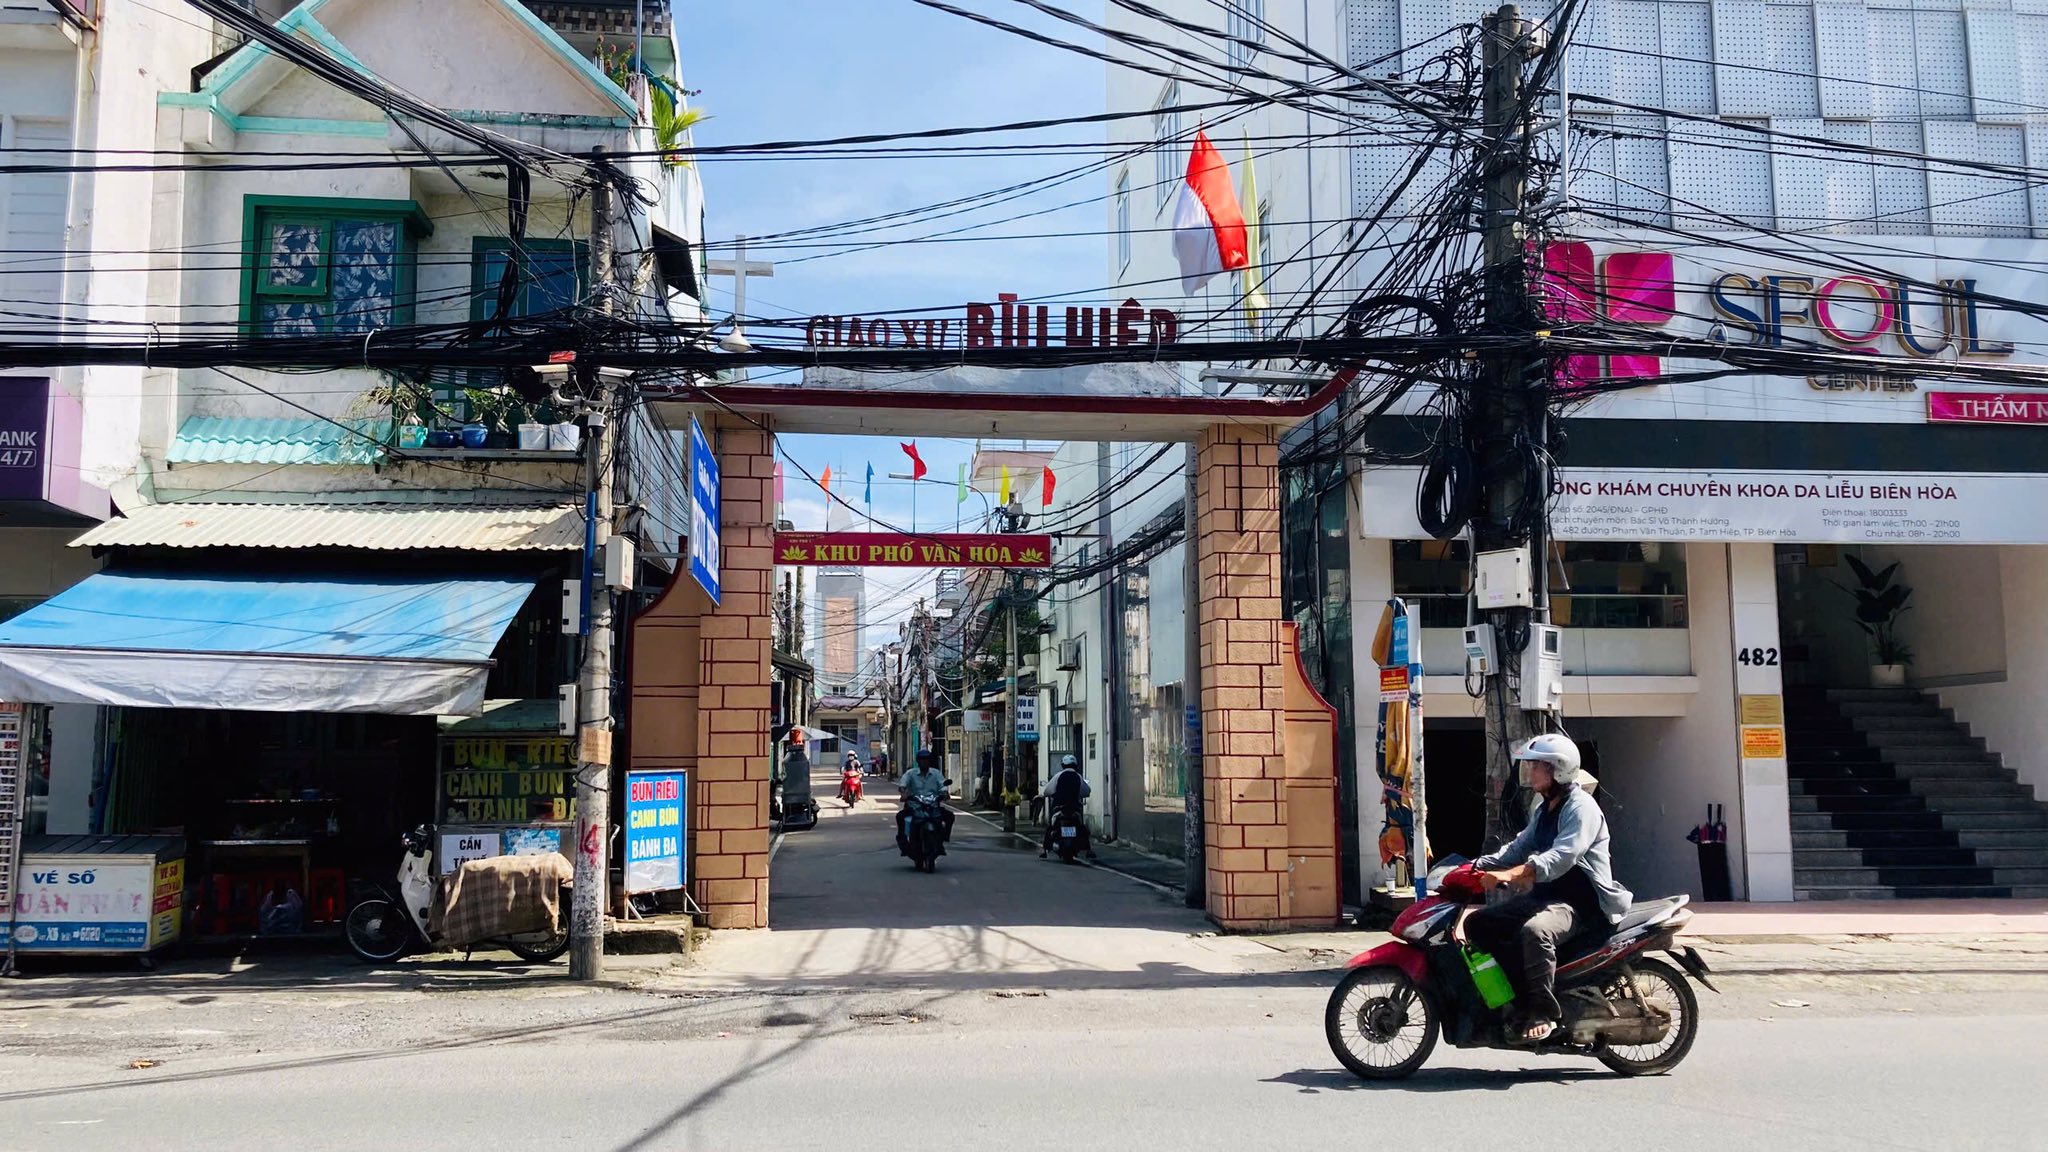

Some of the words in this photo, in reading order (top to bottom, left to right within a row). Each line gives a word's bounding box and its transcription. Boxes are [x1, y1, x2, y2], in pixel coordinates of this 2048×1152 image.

[1710, 273, 2014, 358] SEOUL
[1807, 373, 1917, 393] CENTER
[1957, 394, 2028, 419] THẨM
[1597, 479, 1652, 496] KHÁM
[1657, 480, 1732, 497] CHUYÊN
[1738, 484, 1789, 498] KHOA
[1794, 485, 1820, 498] DA
[1825, 480, 1863, 499] LIỄU
[1870, 483, 1911, 499] BIÊN
[1917, 482, 1957, 500] HÒA
[814, 545, 861, 562] KHU
[868, 541, 914, 562] PHỐ
[968, 543, 1013, 563] HÓA
[1738, 647, 1778, 666] 482
[655, 775, 678, 801] RIÊU
[631, 808, 657, 829] CANH
[659, 803, 679, 827] BÚN
[631, 834, 661, 859] BÁNH
[32, 870, 59, 884] VÉ
[68, 868, 98, 885] SỐ
